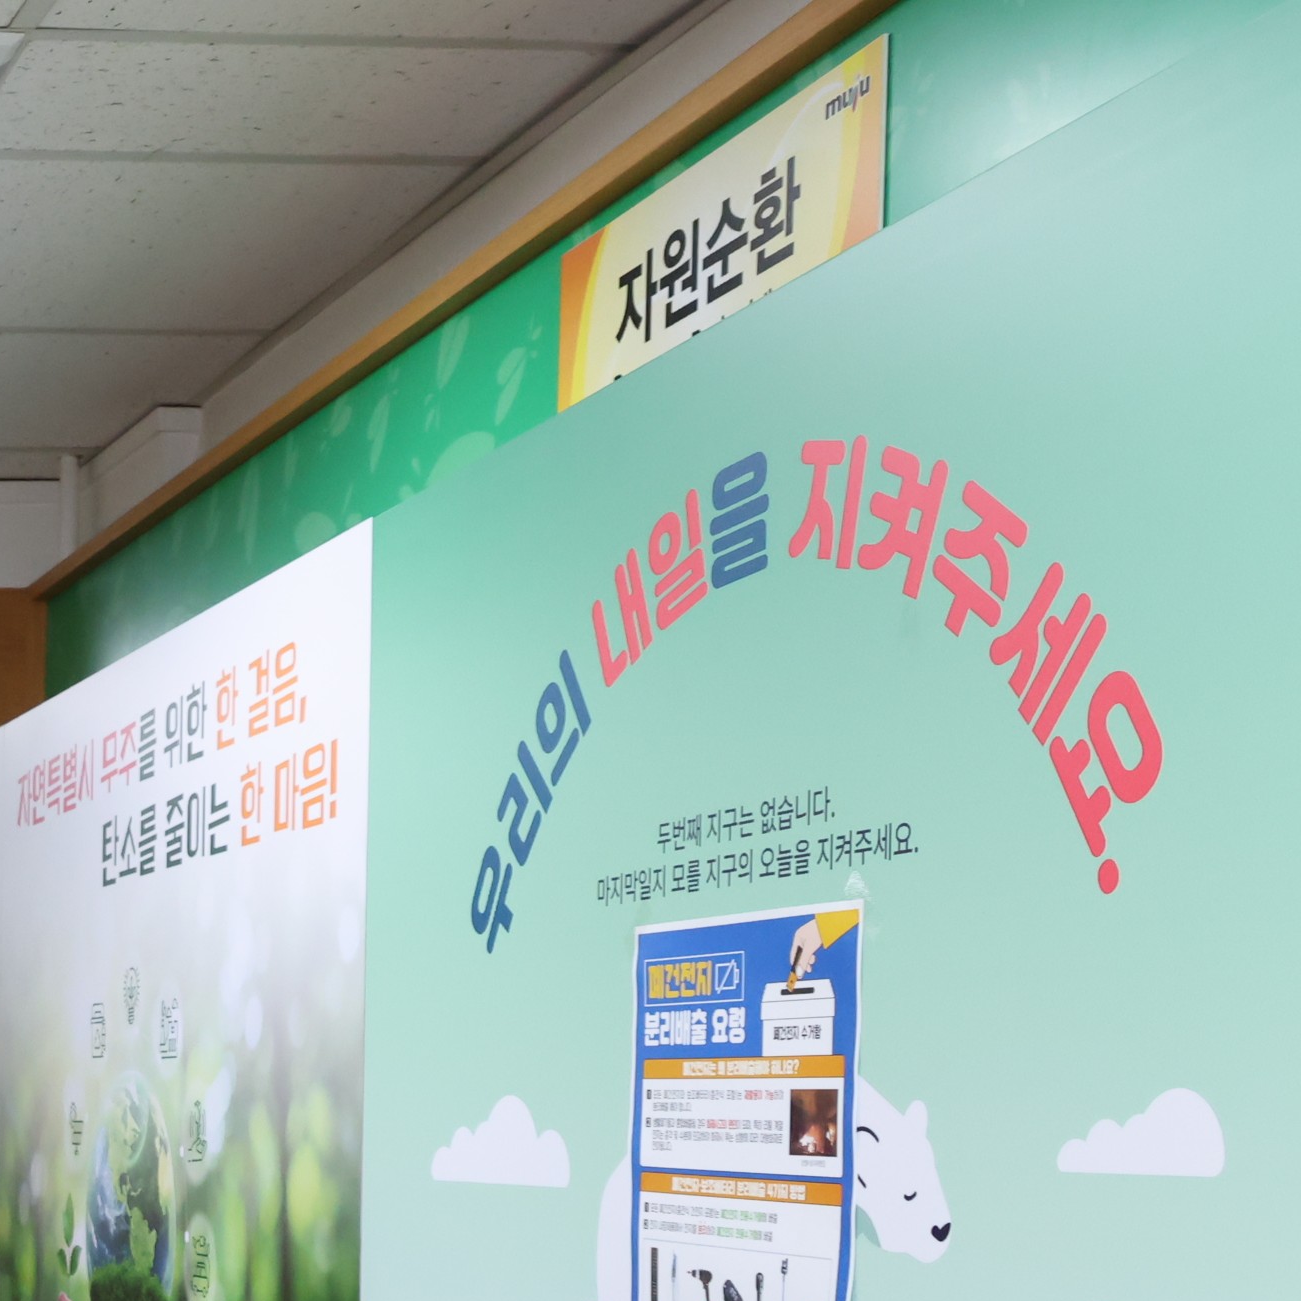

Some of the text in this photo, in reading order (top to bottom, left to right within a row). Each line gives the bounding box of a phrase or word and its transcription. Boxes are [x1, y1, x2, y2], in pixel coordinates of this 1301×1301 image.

[614, 156, 802, 345] 자원순환
[17, 641, 308, 829] 자연특별시 무주를 위한 한 걸음,
[470, 649, 592, 954] 우리의
[591, 451, 770, 688] 내일을
[101, 738, 338, 888] 탄소를 줄이는 한 마음!
[596, 822, 919, 907] 마지막일지 모를 지구의 오늘을 지켜주세요.
[657, 785, 836, 854] 두번째 지구는 없습니다.
[644, 1006, 746, 1047] 분리배출 요령
